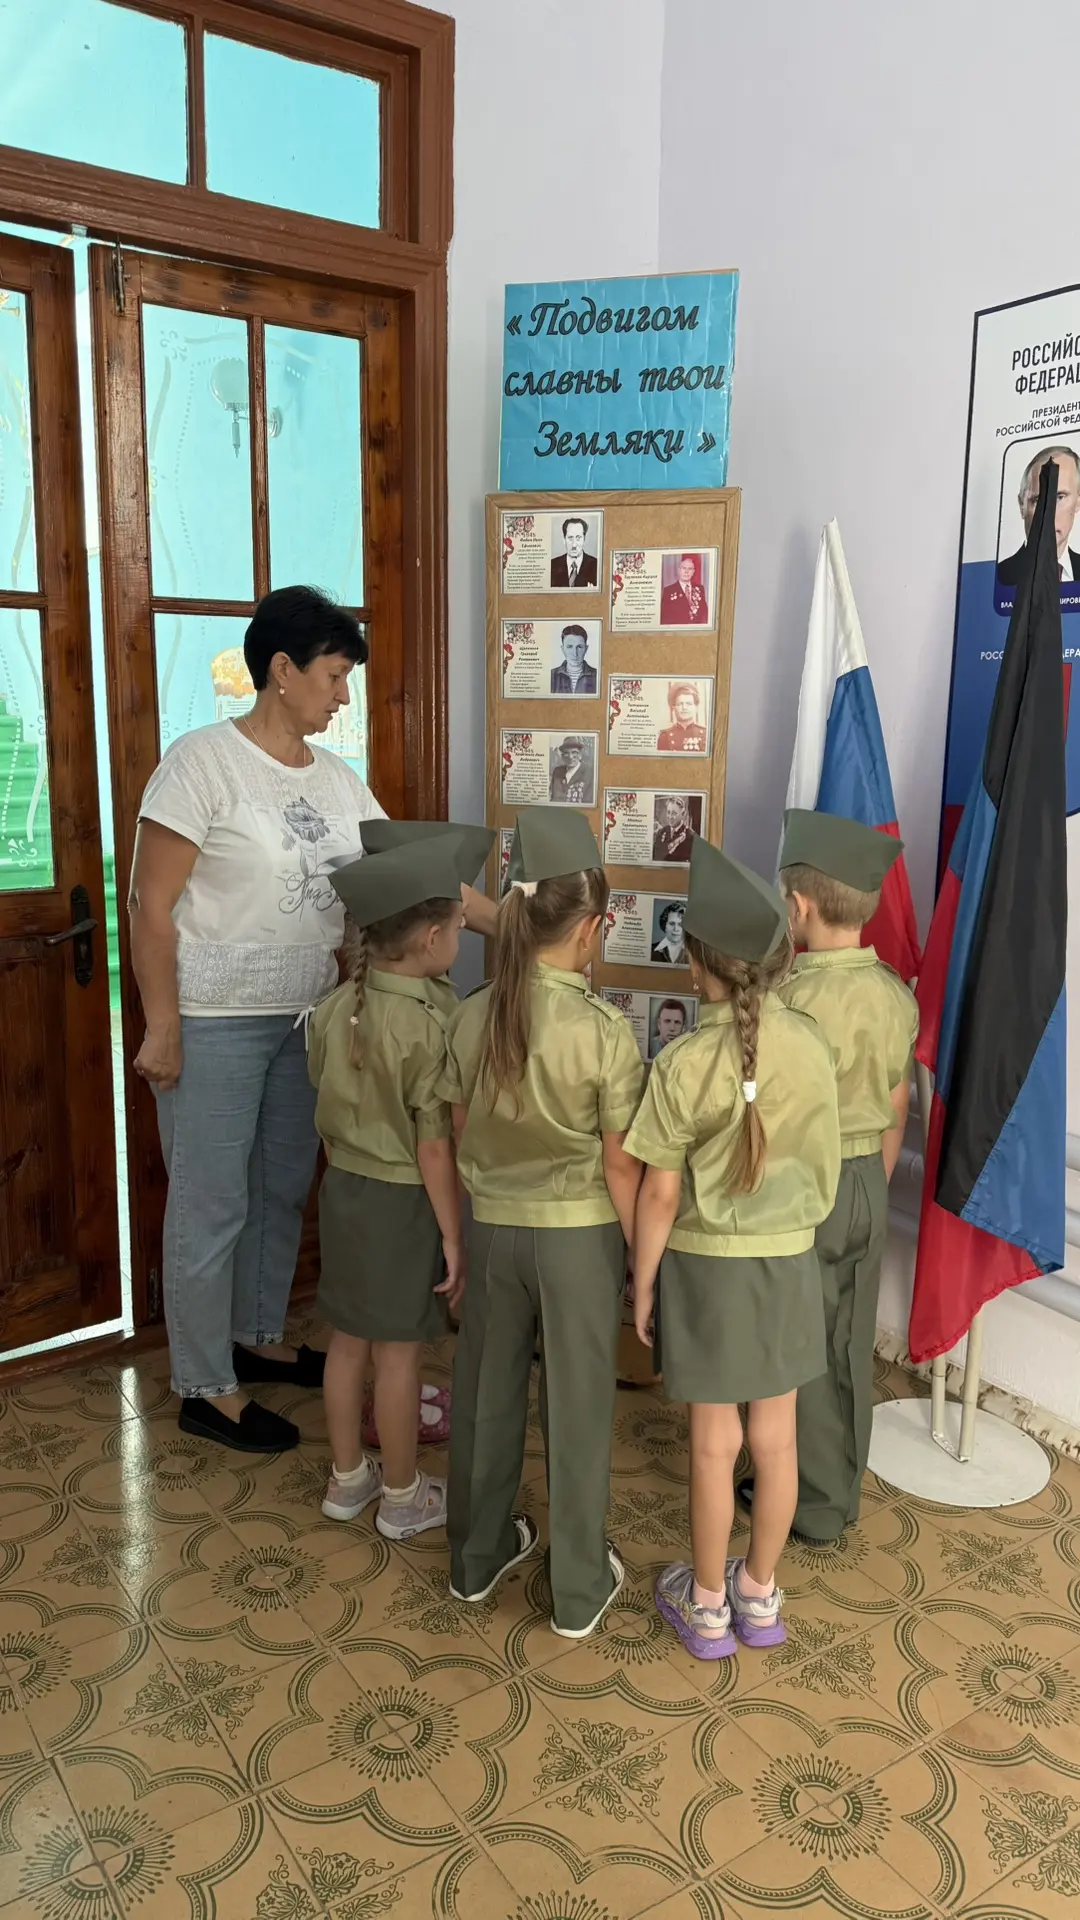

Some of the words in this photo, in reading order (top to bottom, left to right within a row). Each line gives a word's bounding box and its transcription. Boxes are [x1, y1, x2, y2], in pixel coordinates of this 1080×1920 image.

[504, 368, 622, 397] славны
[638, 364, 725, 393] твои
[534, 421, 685, 463] Земляки
[996, 416, 1060, 437] РОССИЙСКОЙ
